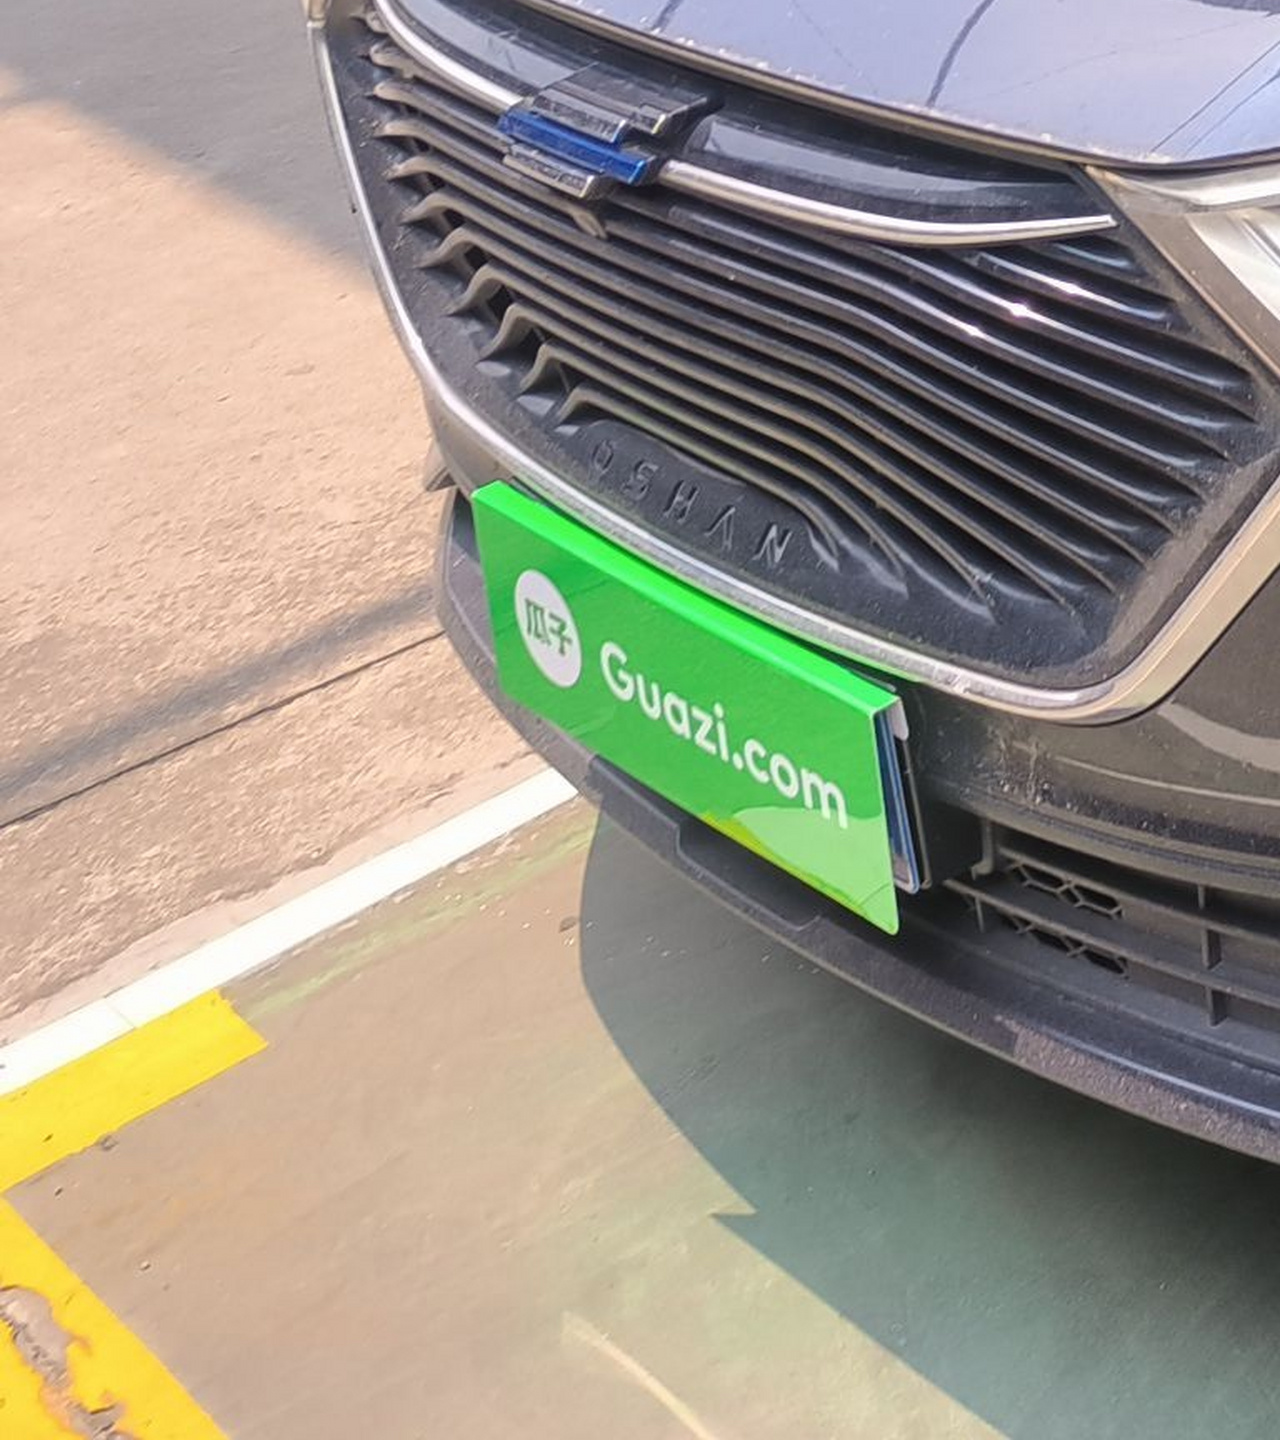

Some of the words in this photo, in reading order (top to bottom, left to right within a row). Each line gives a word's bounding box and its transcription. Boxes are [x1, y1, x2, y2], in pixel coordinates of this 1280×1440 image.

[590, 440, 796, 568] OSHAN
[524, 598, 573, 656] 瓜子
[599, 640, 848, 830] Guazi.com
